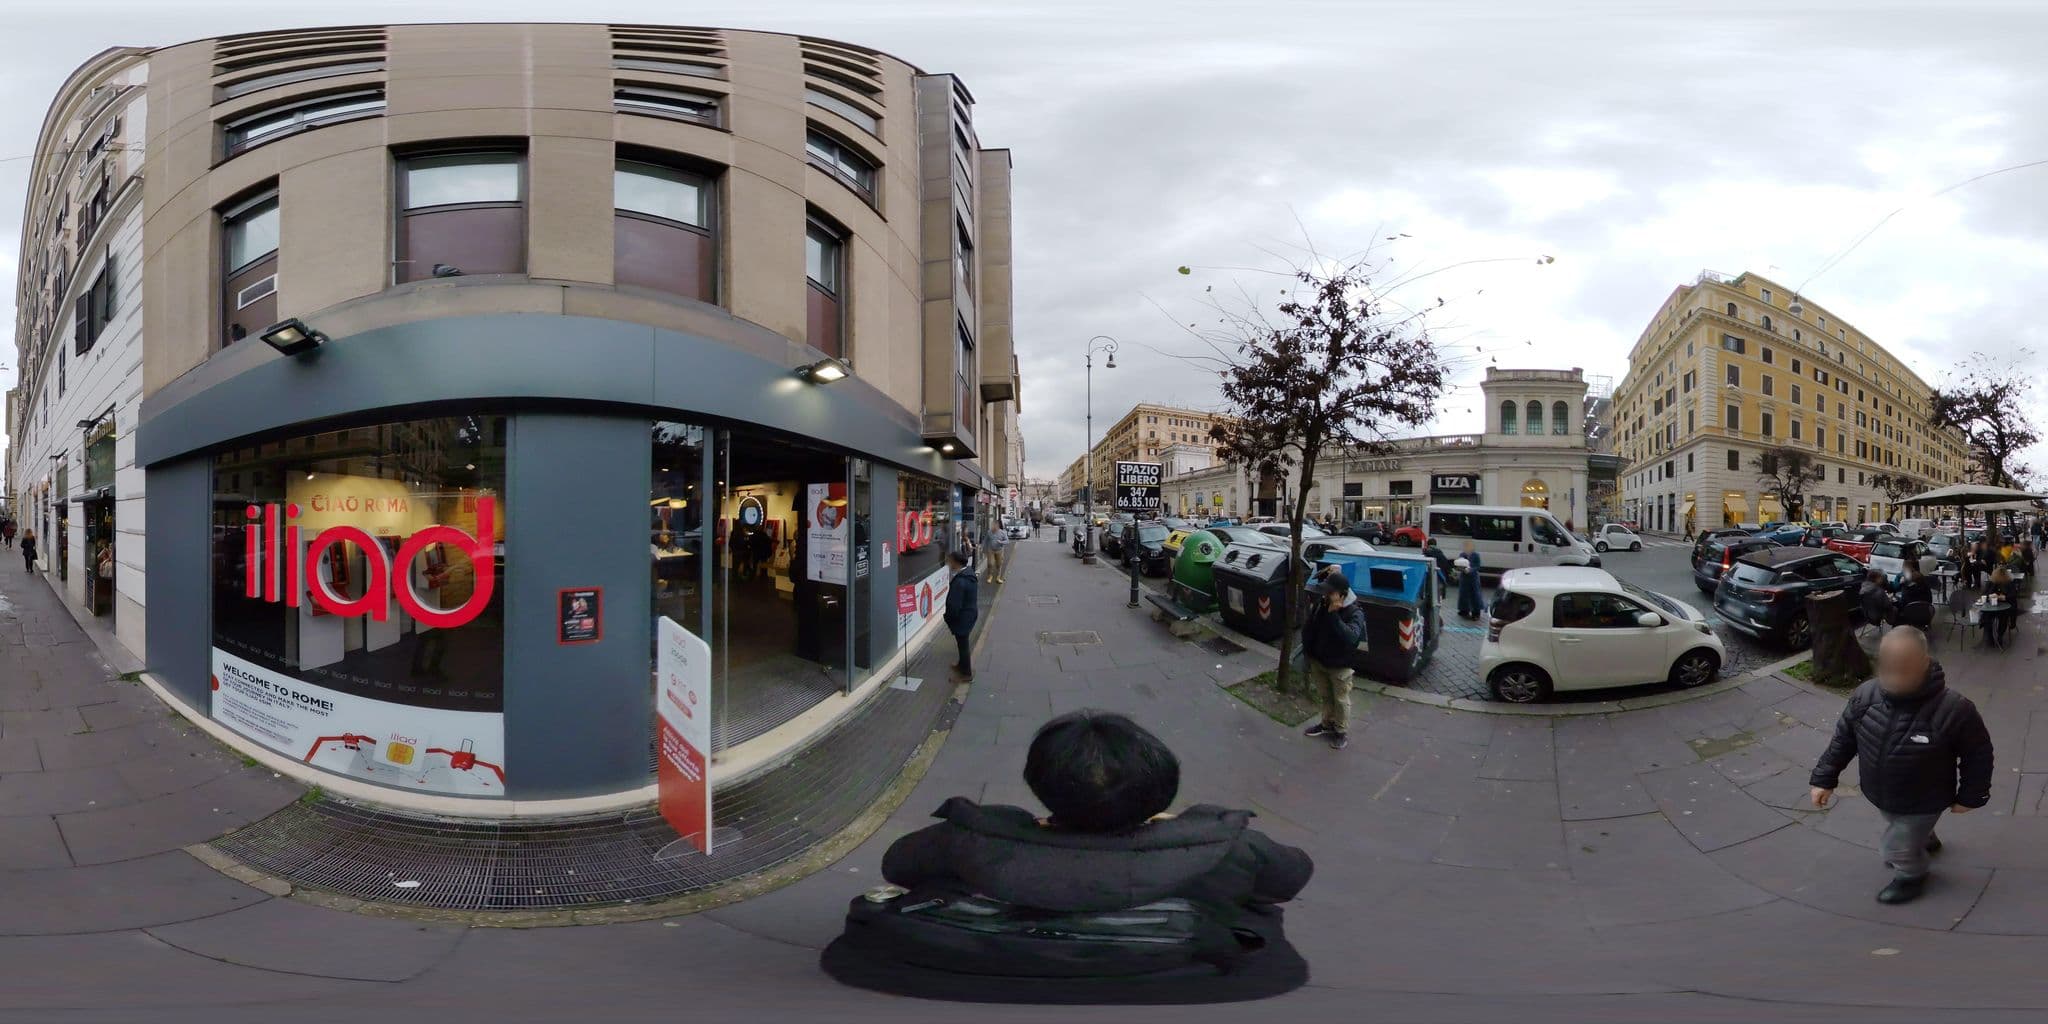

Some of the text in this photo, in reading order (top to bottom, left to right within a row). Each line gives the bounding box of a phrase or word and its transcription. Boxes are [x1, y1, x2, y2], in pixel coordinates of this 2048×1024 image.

[1120, 465, 1159, 475] SPAZIO
[1120, 475, 1158, 485] LIBERO
[1437, 477, 1470, 488] LIZA
[1130, 487, 1147, 497] 347
[312, 495, 408, 513] CIAO ROMA
[1118, 496, 1160, 508] 66.85.107
[246, 496, 496, 629] iliad
[223, 662, 270, 690] WELCOME
[273, 684, 289, 696] TO
[292, 691, 334, 712] ROME!
[265, 691, 277, 700] AND
[278, 697, 295, 706] MAKE
[296, 702, 308, 711] THE
[310, 708, 329, 717] MOST
[390, 733, 417, 745] iliad
